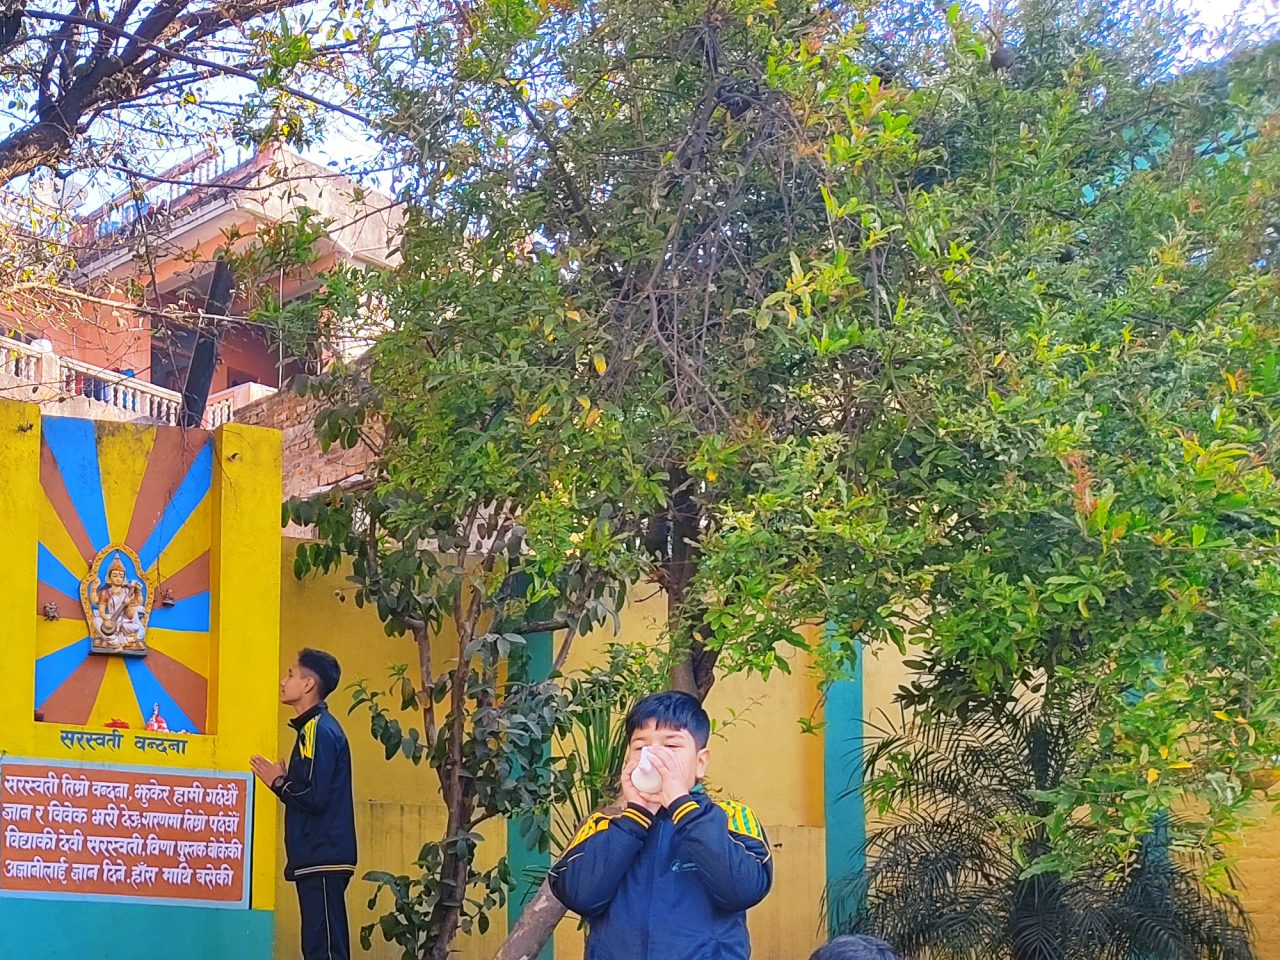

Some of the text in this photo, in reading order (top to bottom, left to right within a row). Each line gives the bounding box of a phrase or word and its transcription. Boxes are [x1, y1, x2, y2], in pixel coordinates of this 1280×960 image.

[60, 729, 188, 756] सरस्वती वन्दना
[4, 771, 60, 797] सरस्वती
[61, 773, 90, 798] तिम्रो
[91, 781, 132, 801] वन्दना,
[134, 779, 171, 807] झुकेर
[173, 781, 205, 807] हामी
[35, 805, 45, 825] र
[47, 800, 88, 824] विवेक
[91, 803, 119, 829] भरी
[141, 812, 183, 832] शरणमा
[183, 809, 208, 832] तिम्रो
[5, 824, 57, 850] विद्याकी
[59, 829, 84, 853] देवी
[146, 834, 176, 856] विणा
[177, 840, 207, 862] पुस्तक
[4, 856, 69, 884] अज्ञानीलाई
[71, 863, 100, 884] ज्ञान
[162, 863, 194, 885] माथि
[196, 864, 234, 890] बसेकी
